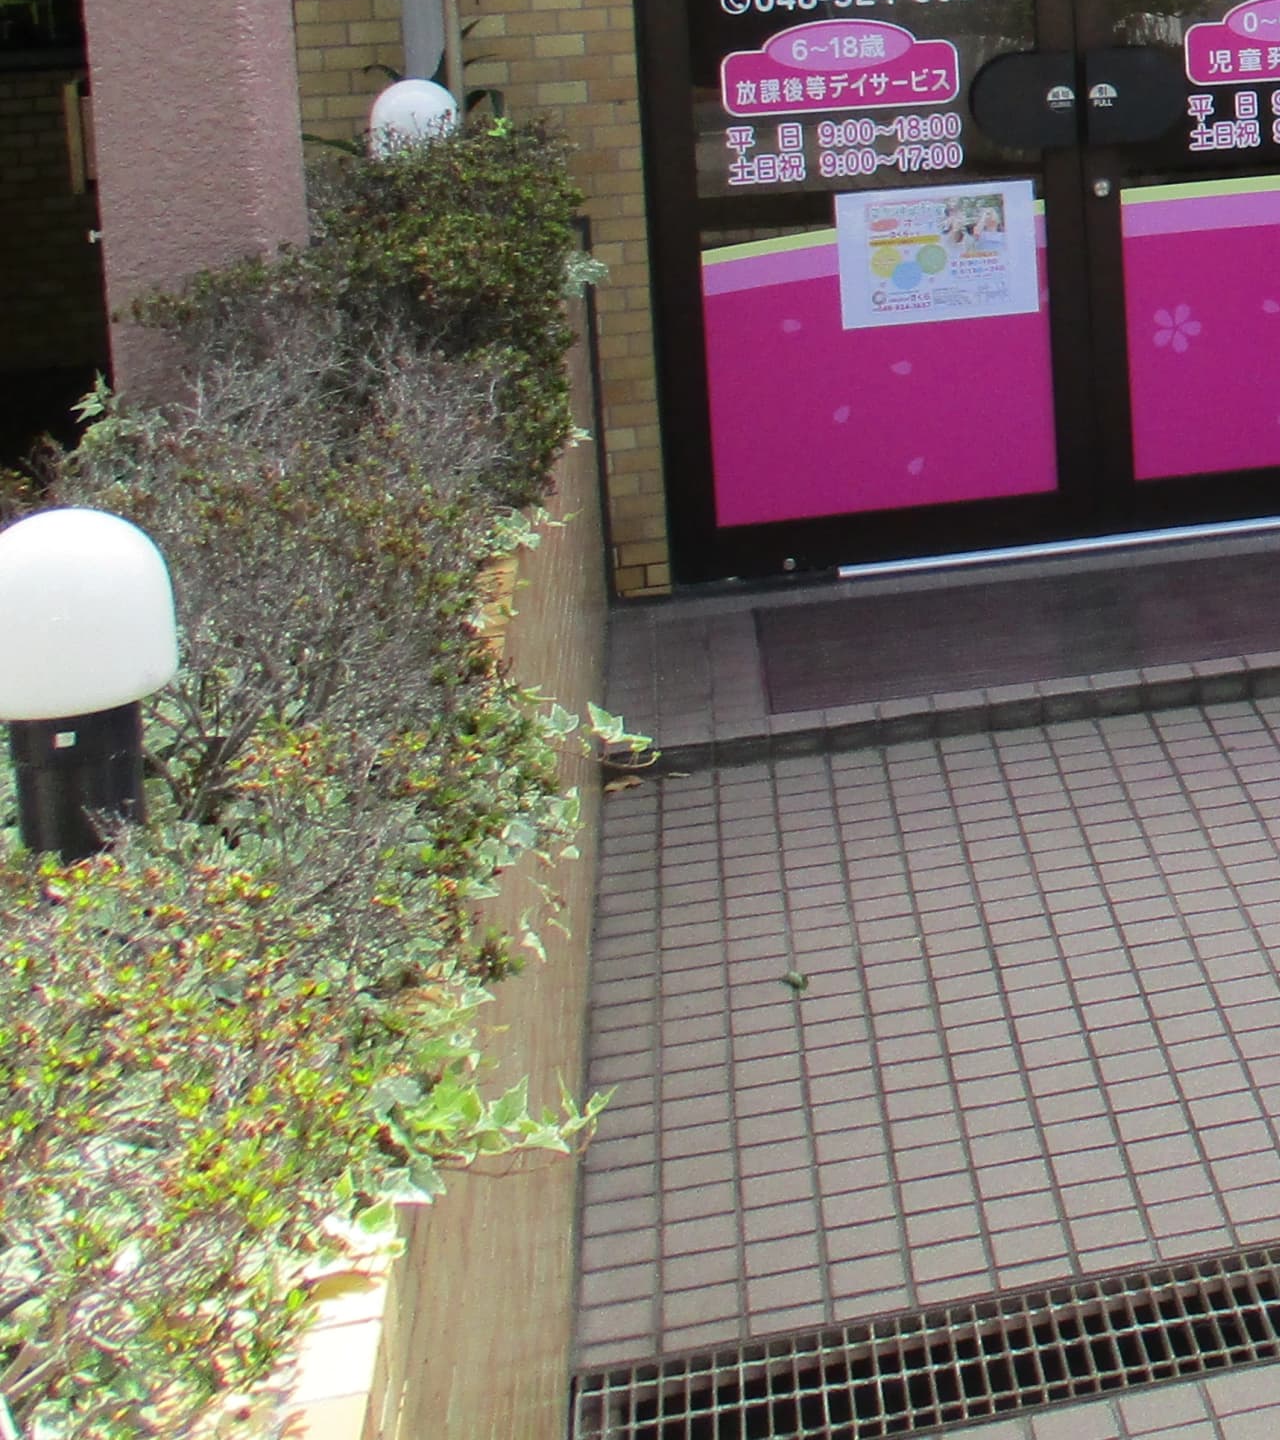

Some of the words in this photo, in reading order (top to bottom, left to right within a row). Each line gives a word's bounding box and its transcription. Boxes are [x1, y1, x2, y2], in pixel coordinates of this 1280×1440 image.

[736, 69, 951, 106] 放課後等デイサービス
[1189, 122, 1260, 151] 土日祝
[728, 153, 806, 185] 土日祝
